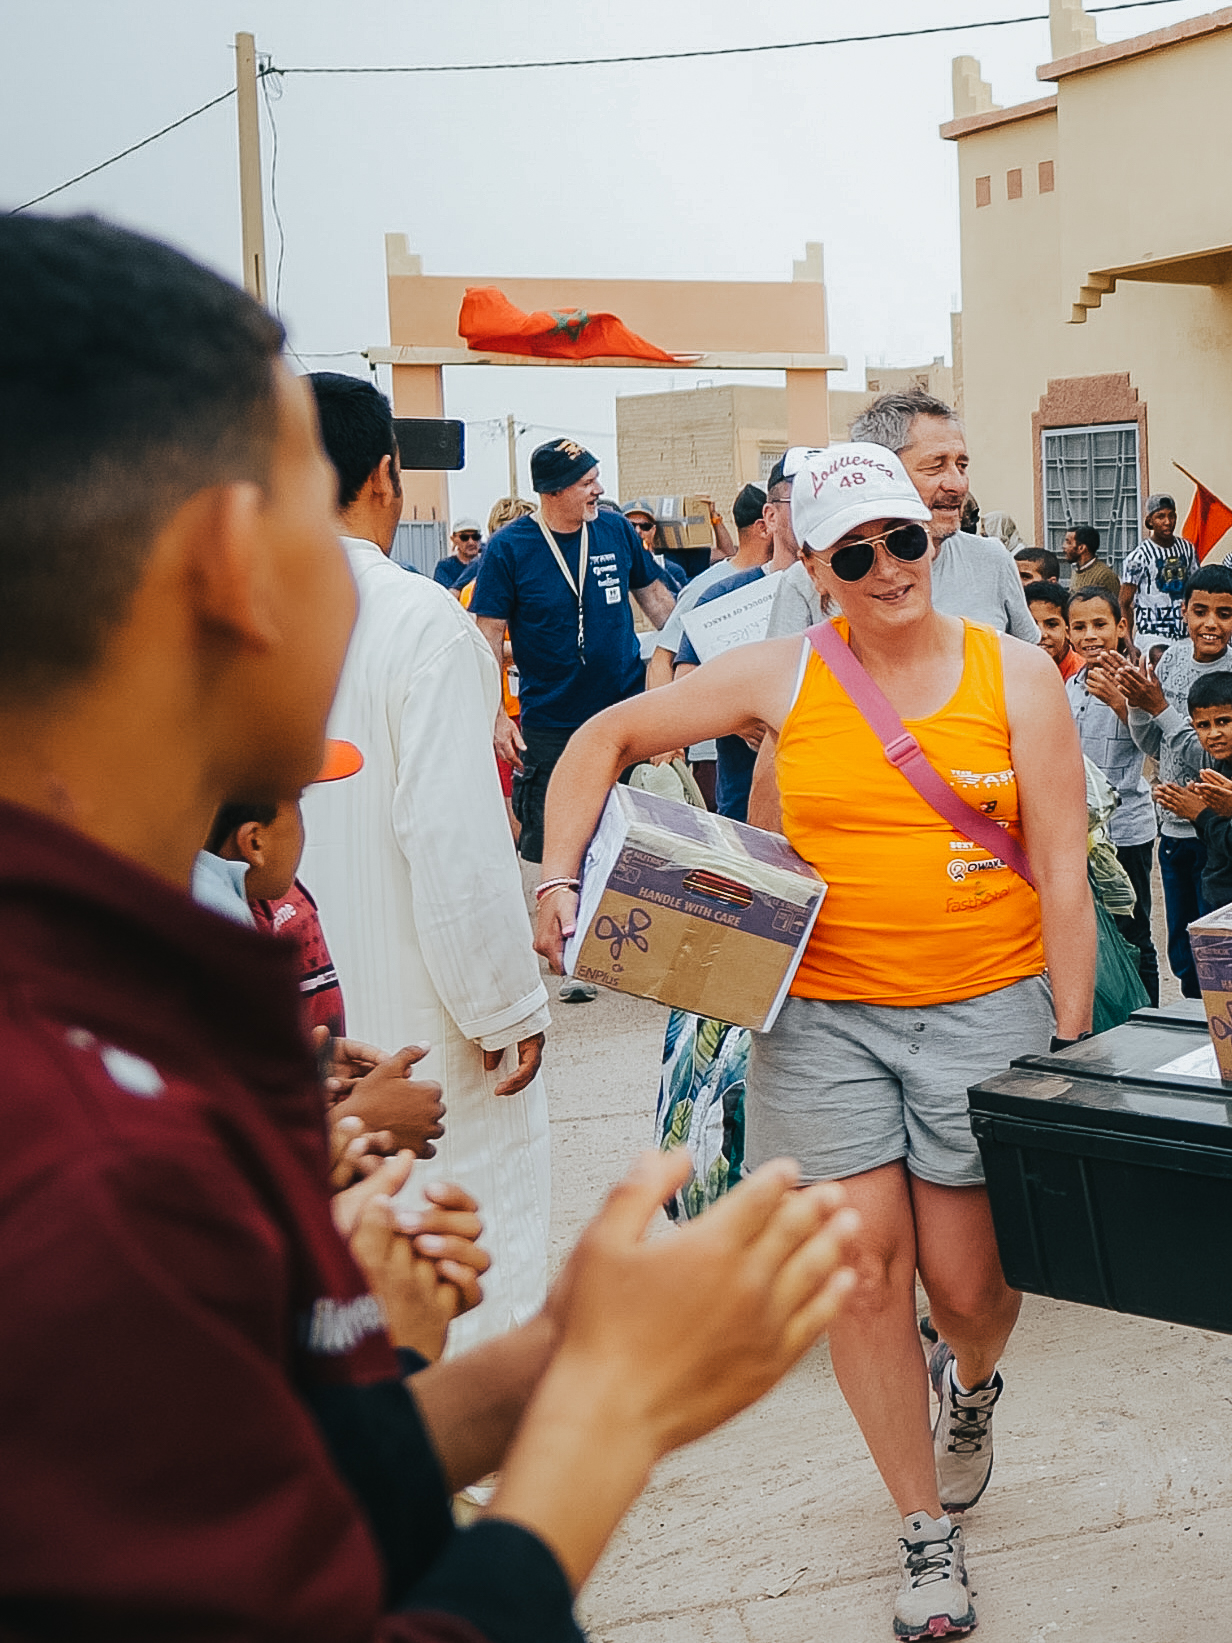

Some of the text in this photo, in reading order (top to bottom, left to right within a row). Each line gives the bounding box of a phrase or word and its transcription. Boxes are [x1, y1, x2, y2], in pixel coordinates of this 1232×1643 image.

[840, 472, 866, 487] 48
[638, 886, 742, 928] HANDLE WITH CARE
